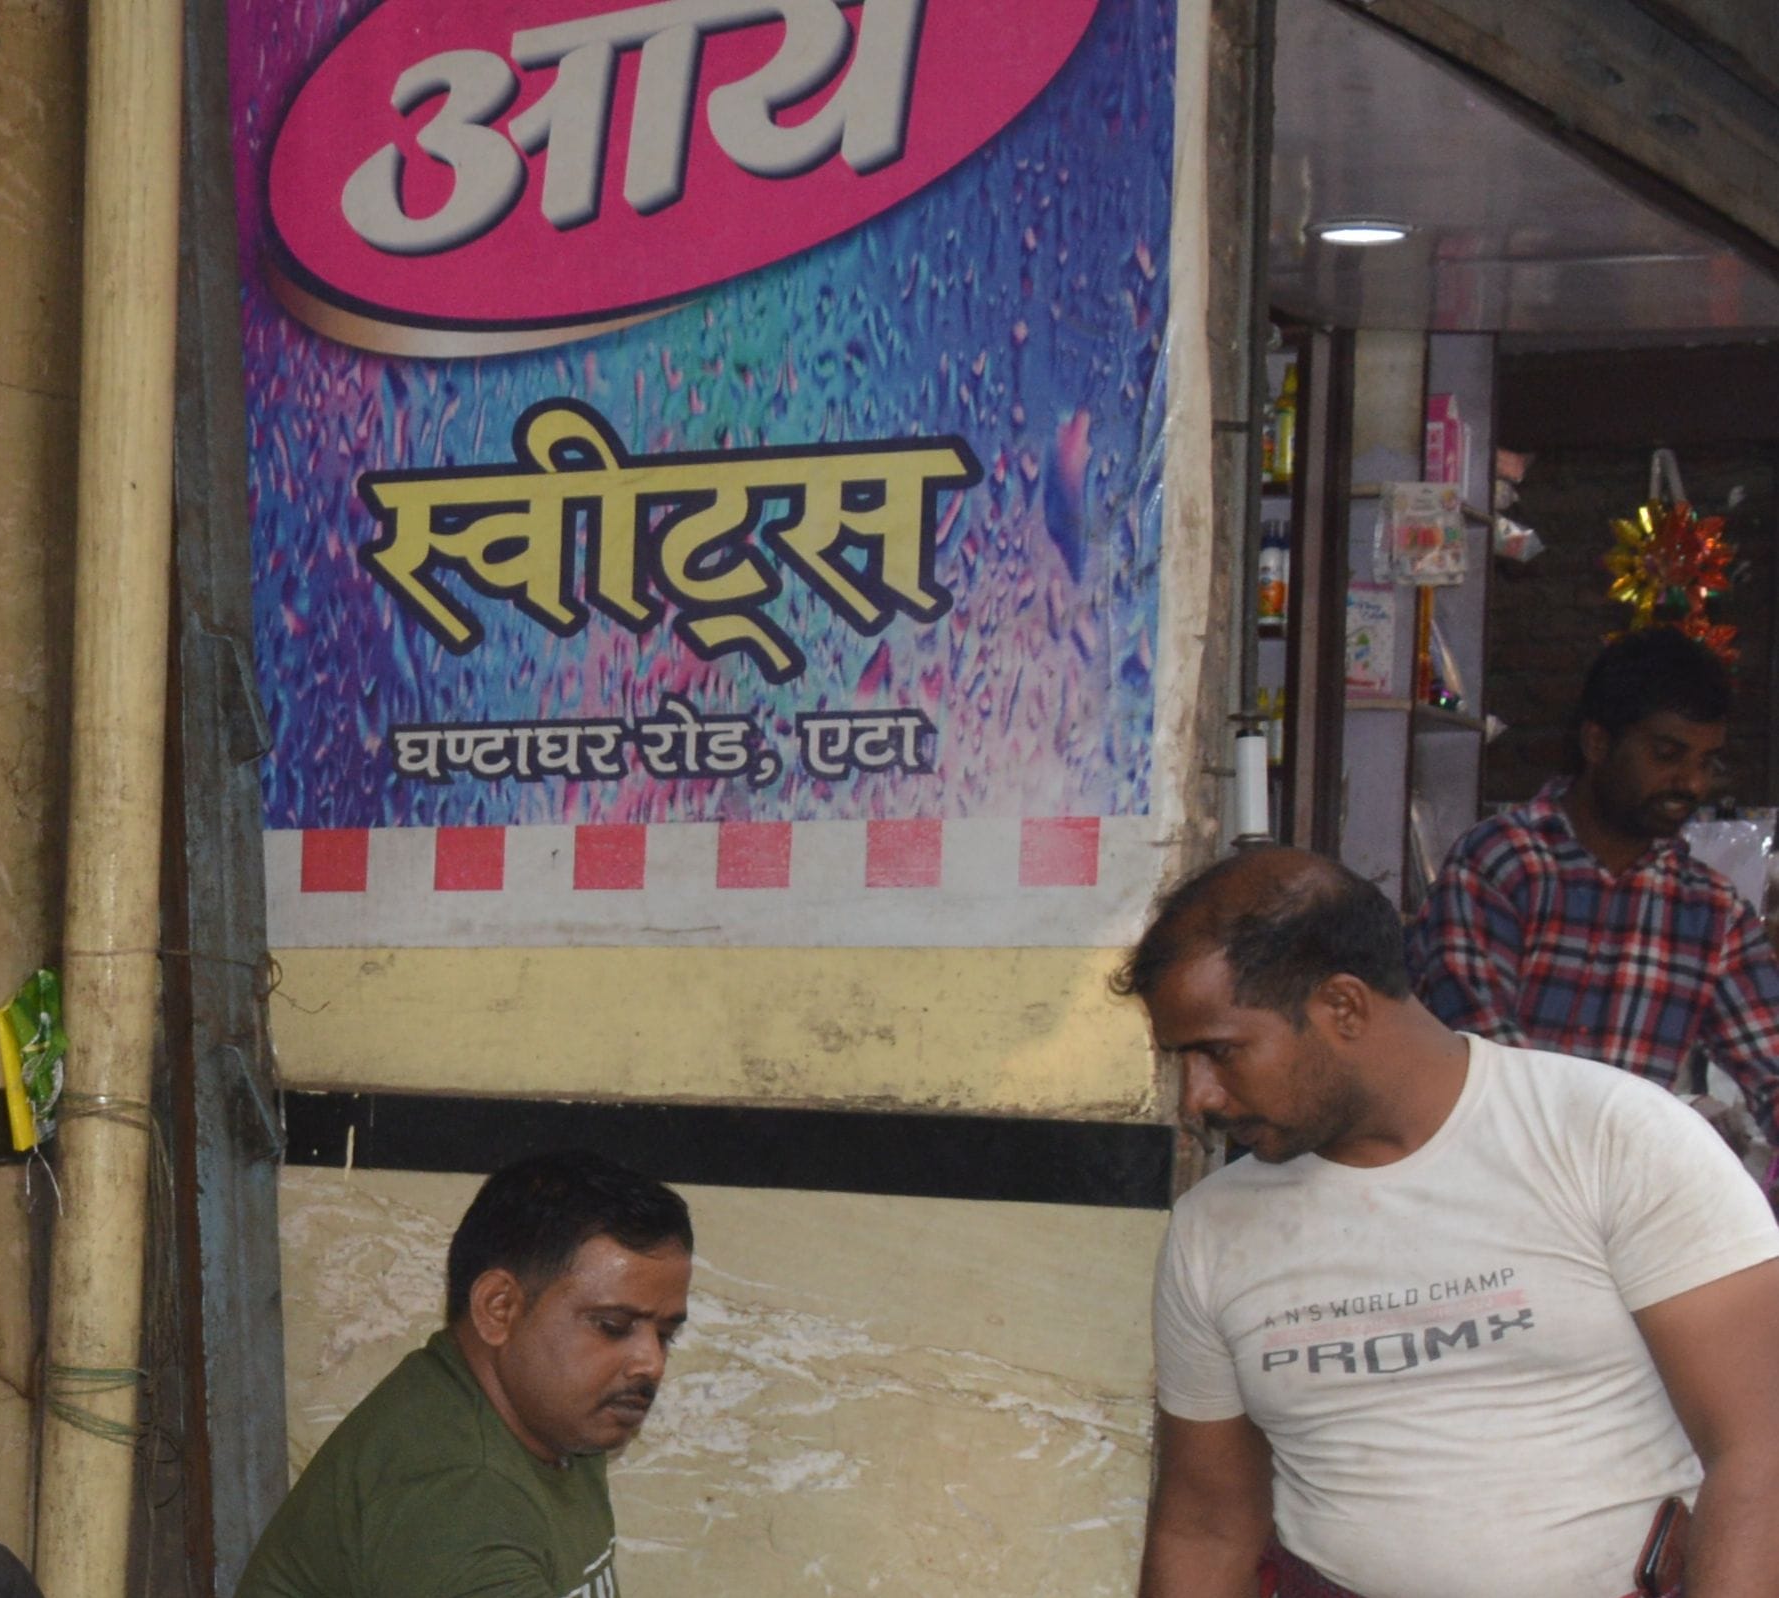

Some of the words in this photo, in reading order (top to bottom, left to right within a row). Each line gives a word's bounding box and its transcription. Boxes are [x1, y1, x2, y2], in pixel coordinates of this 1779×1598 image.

[359, 397, 983, 684] स्वीट्स
[392, 720, 627, 782] घण्टाघर
[640, 701, 779, 782] रोड,
[802, 707, 935, 777] एटा
[1334, 1288, 1418, 1319] WORLD
[1430, 1267, 1515, 1304] CHAMP
[1262, 1308, 1535, 1374] PROMX
